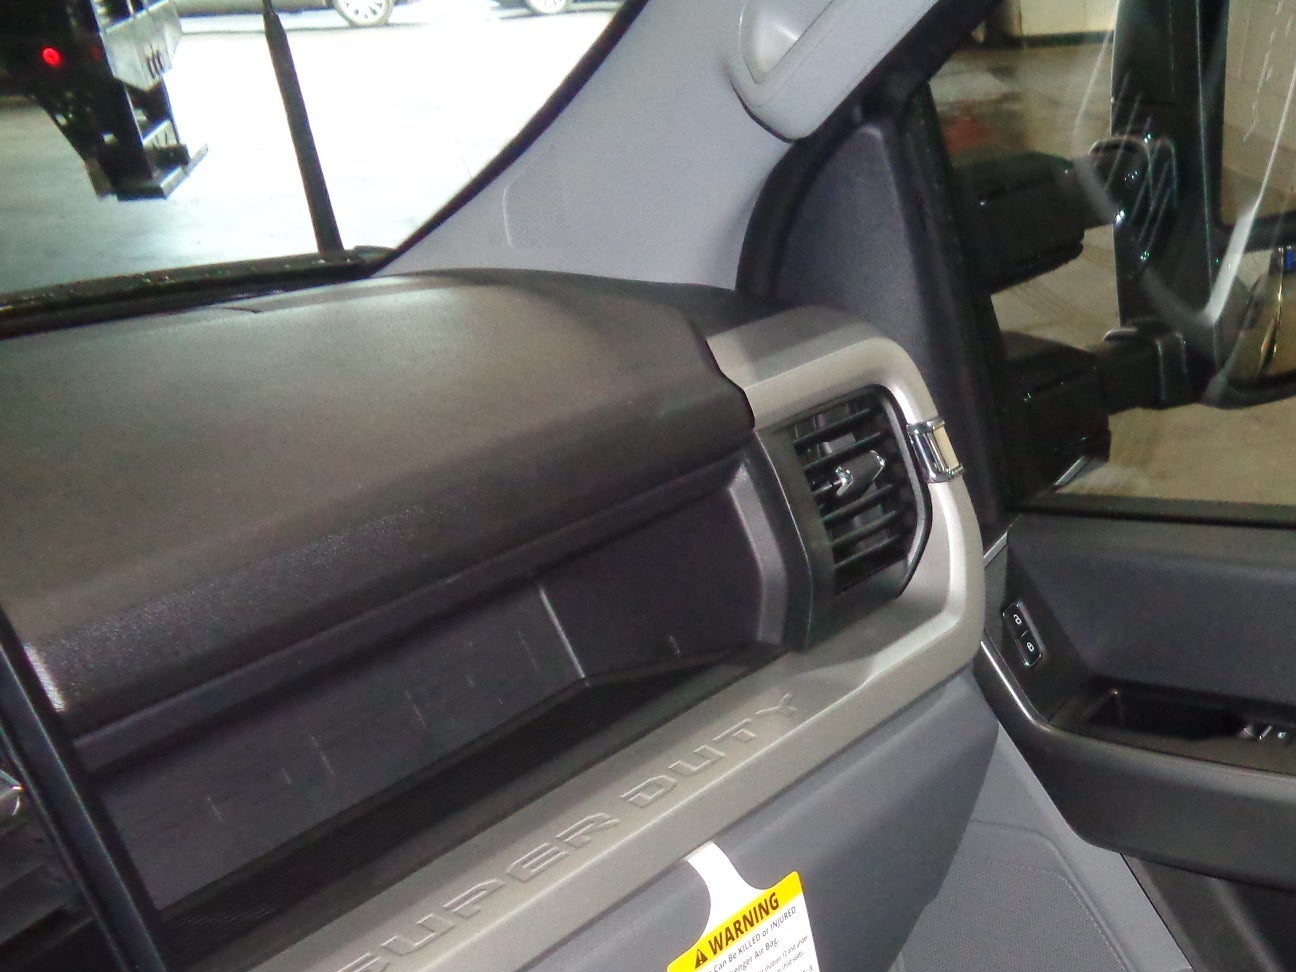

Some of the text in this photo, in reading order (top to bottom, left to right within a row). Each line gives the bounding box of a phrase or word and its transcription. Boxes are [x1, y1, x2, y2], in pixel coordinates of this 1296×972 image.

[620, 692, 798, 809] DUTY
[709, 892, 779, 956] WARNING
[727, 951, 737, 963] Be
[738, 933, 761, 956] KILLED
[762, 928, 769, 937] or
[770, 906, 797, 931] INJURED
[755, 947, 764, 960] Air
